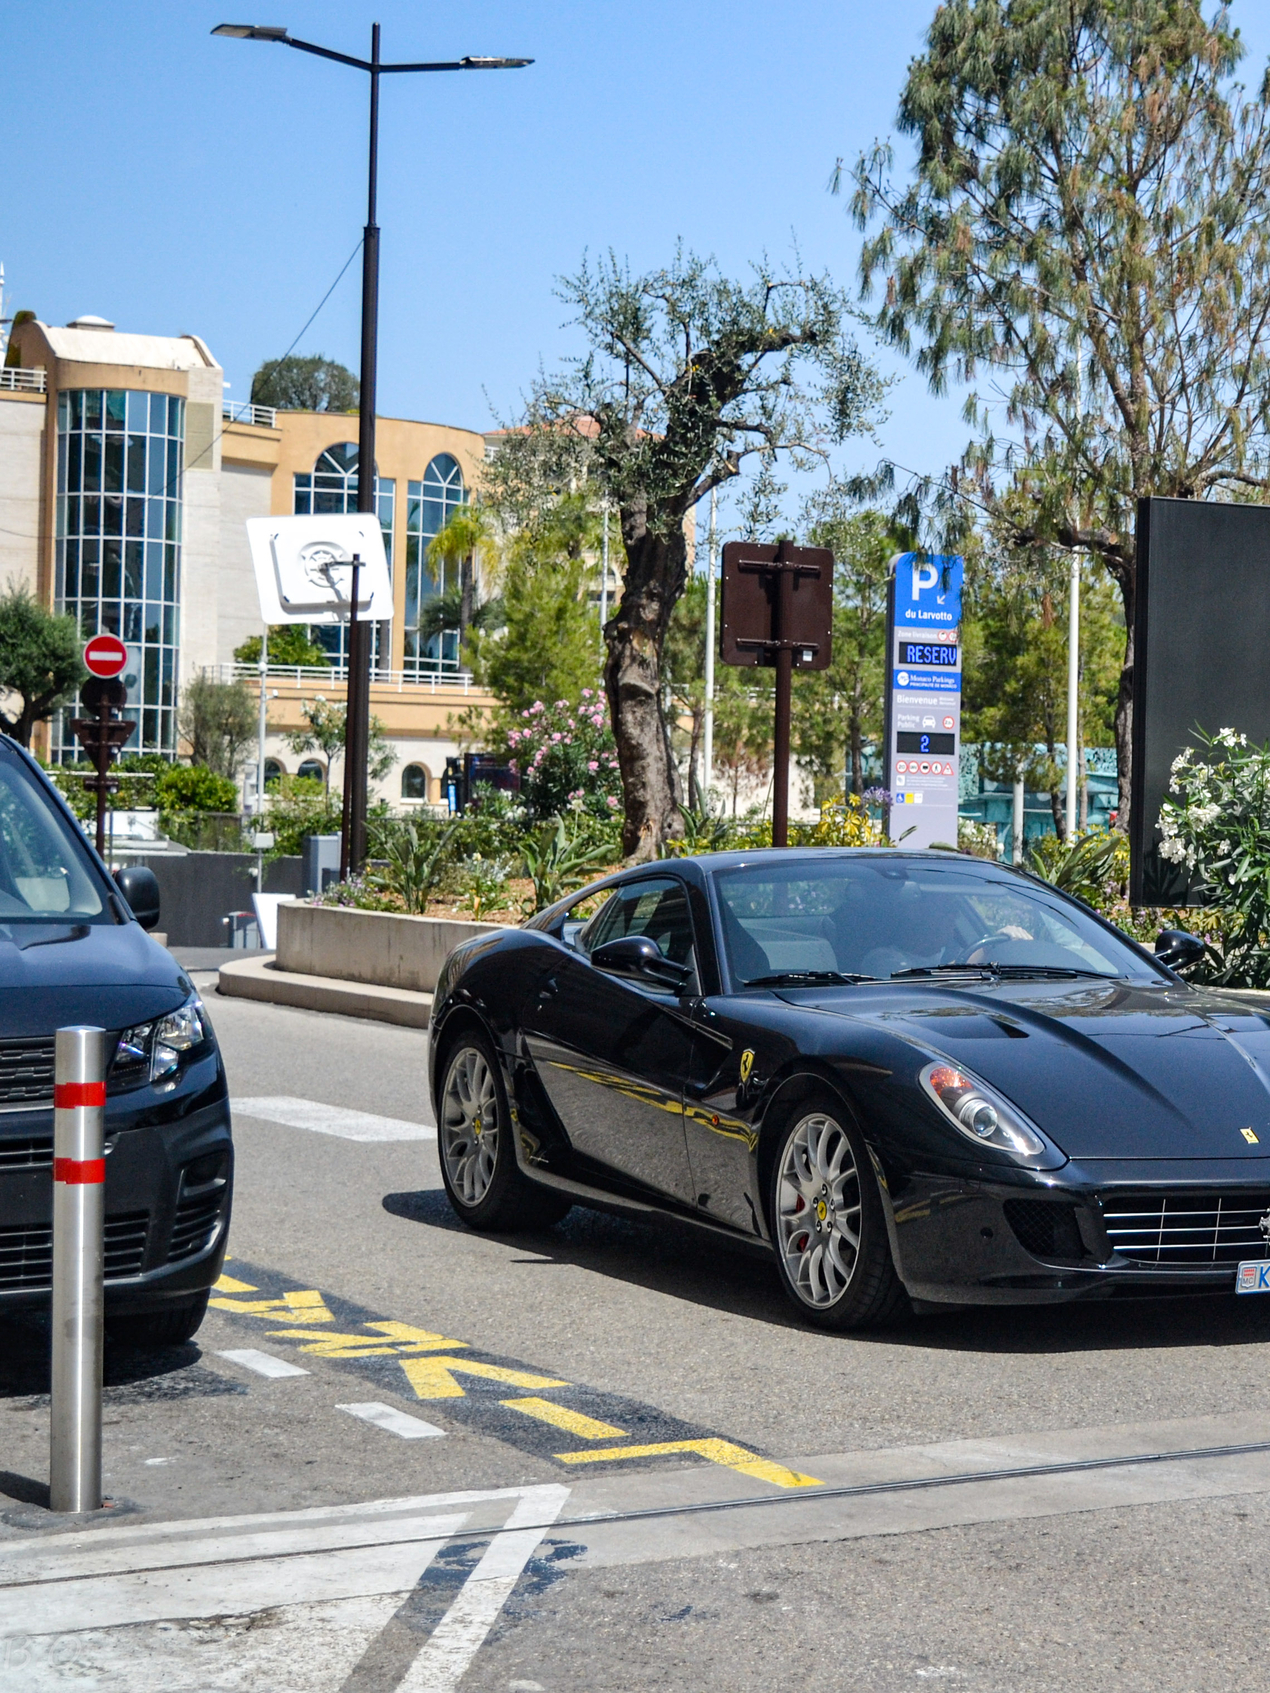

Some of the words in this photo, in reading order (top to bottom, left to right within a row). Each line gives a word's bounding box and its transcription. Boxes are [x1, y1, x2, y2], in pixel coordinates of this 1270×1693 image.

[911, 561, 938, 601] P
[905, 608, 916, 619] du
[918, 609, 952, 621] Larvotto
[910, 674, 932, 683] Monaco
[896, 694, 938, 706] Bienvenue
[897, 713, 920, 723] Parking
[897, 721, 915, 729] Public
[920, 734, 930, 753] 2
